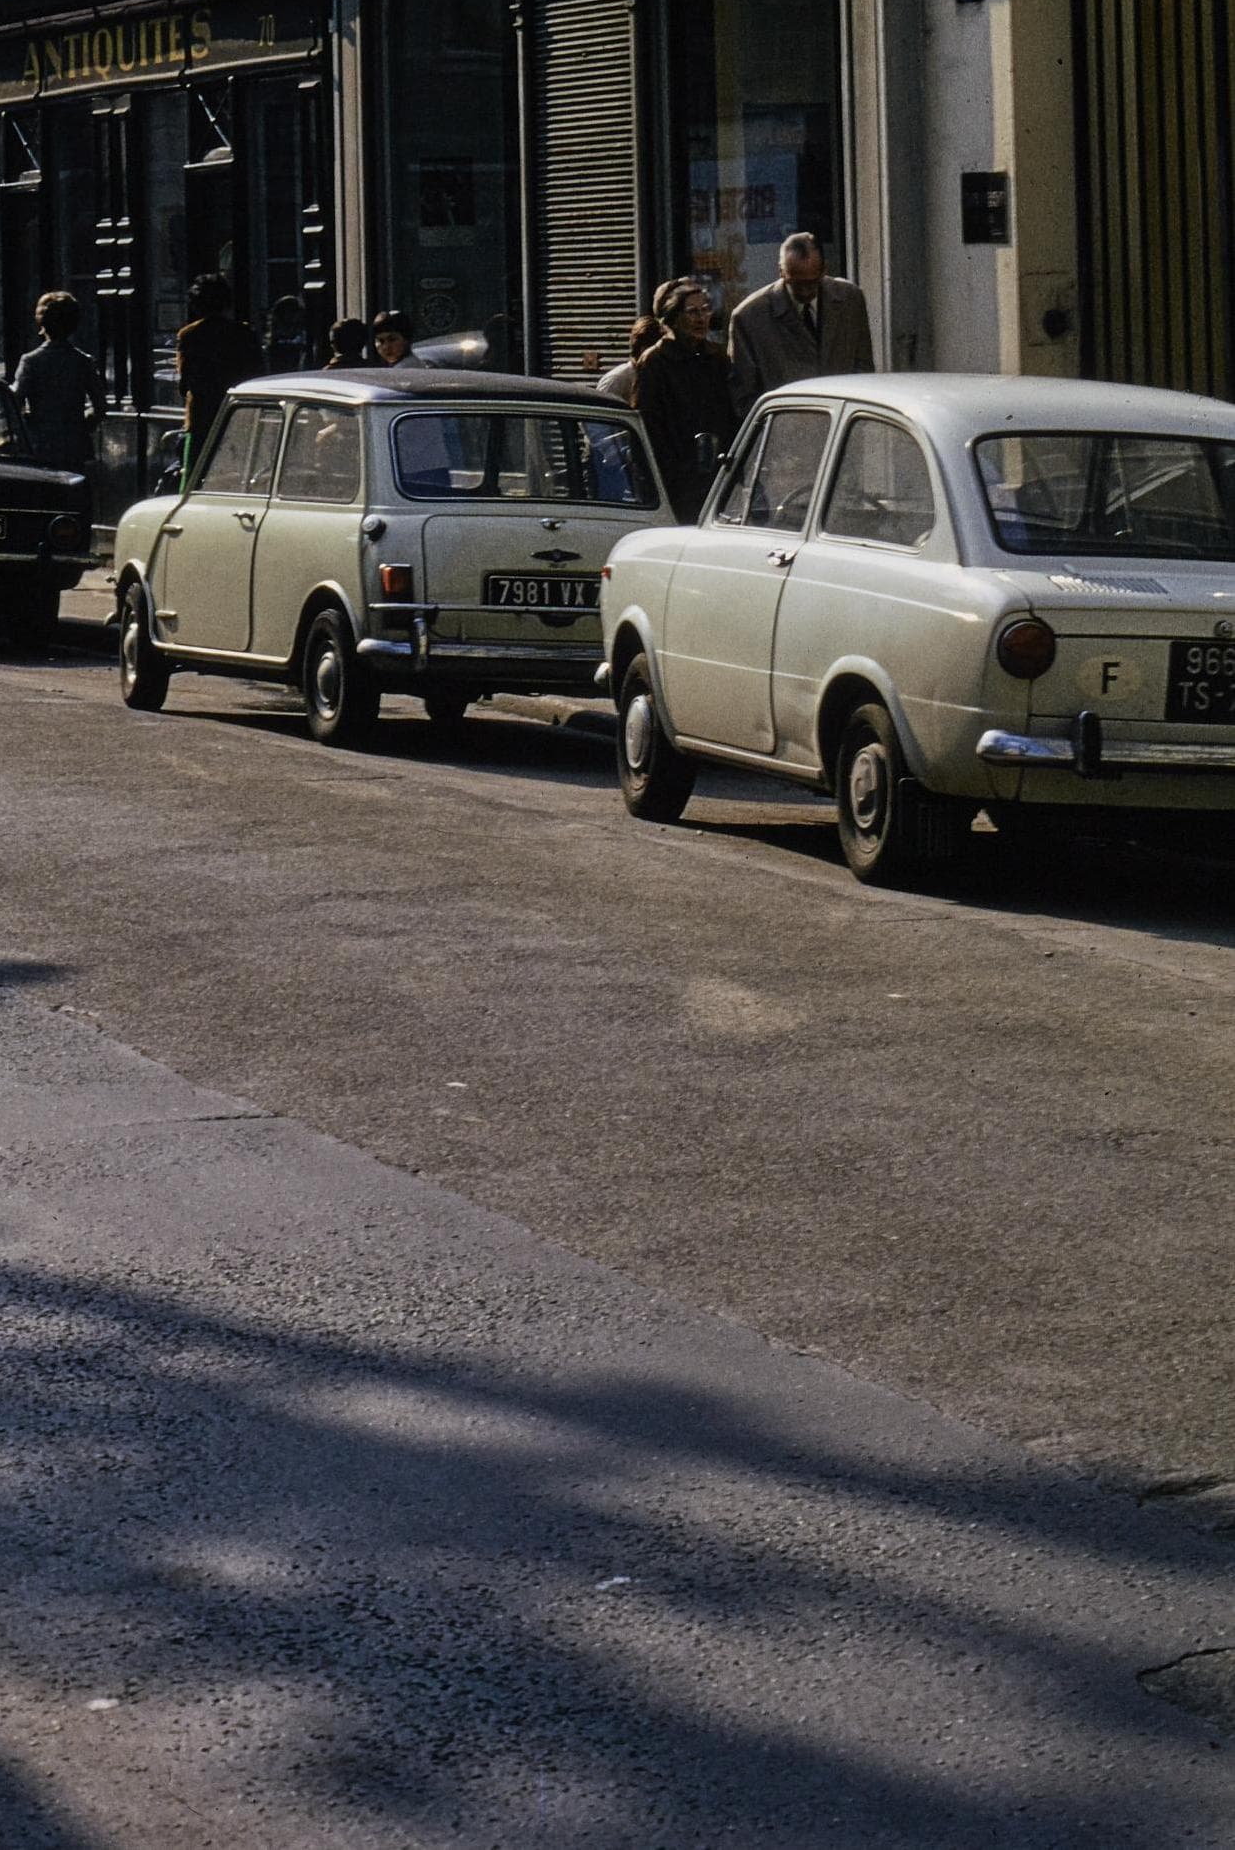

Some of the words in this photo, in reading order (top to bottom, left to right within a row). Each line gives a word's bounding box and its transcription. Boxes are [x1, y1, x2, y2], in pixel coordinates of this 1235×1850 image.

[498, 580, 550, 605] 7981
[560, 582, 585, 606] VX
[1101, 662, 1120, 694] F
